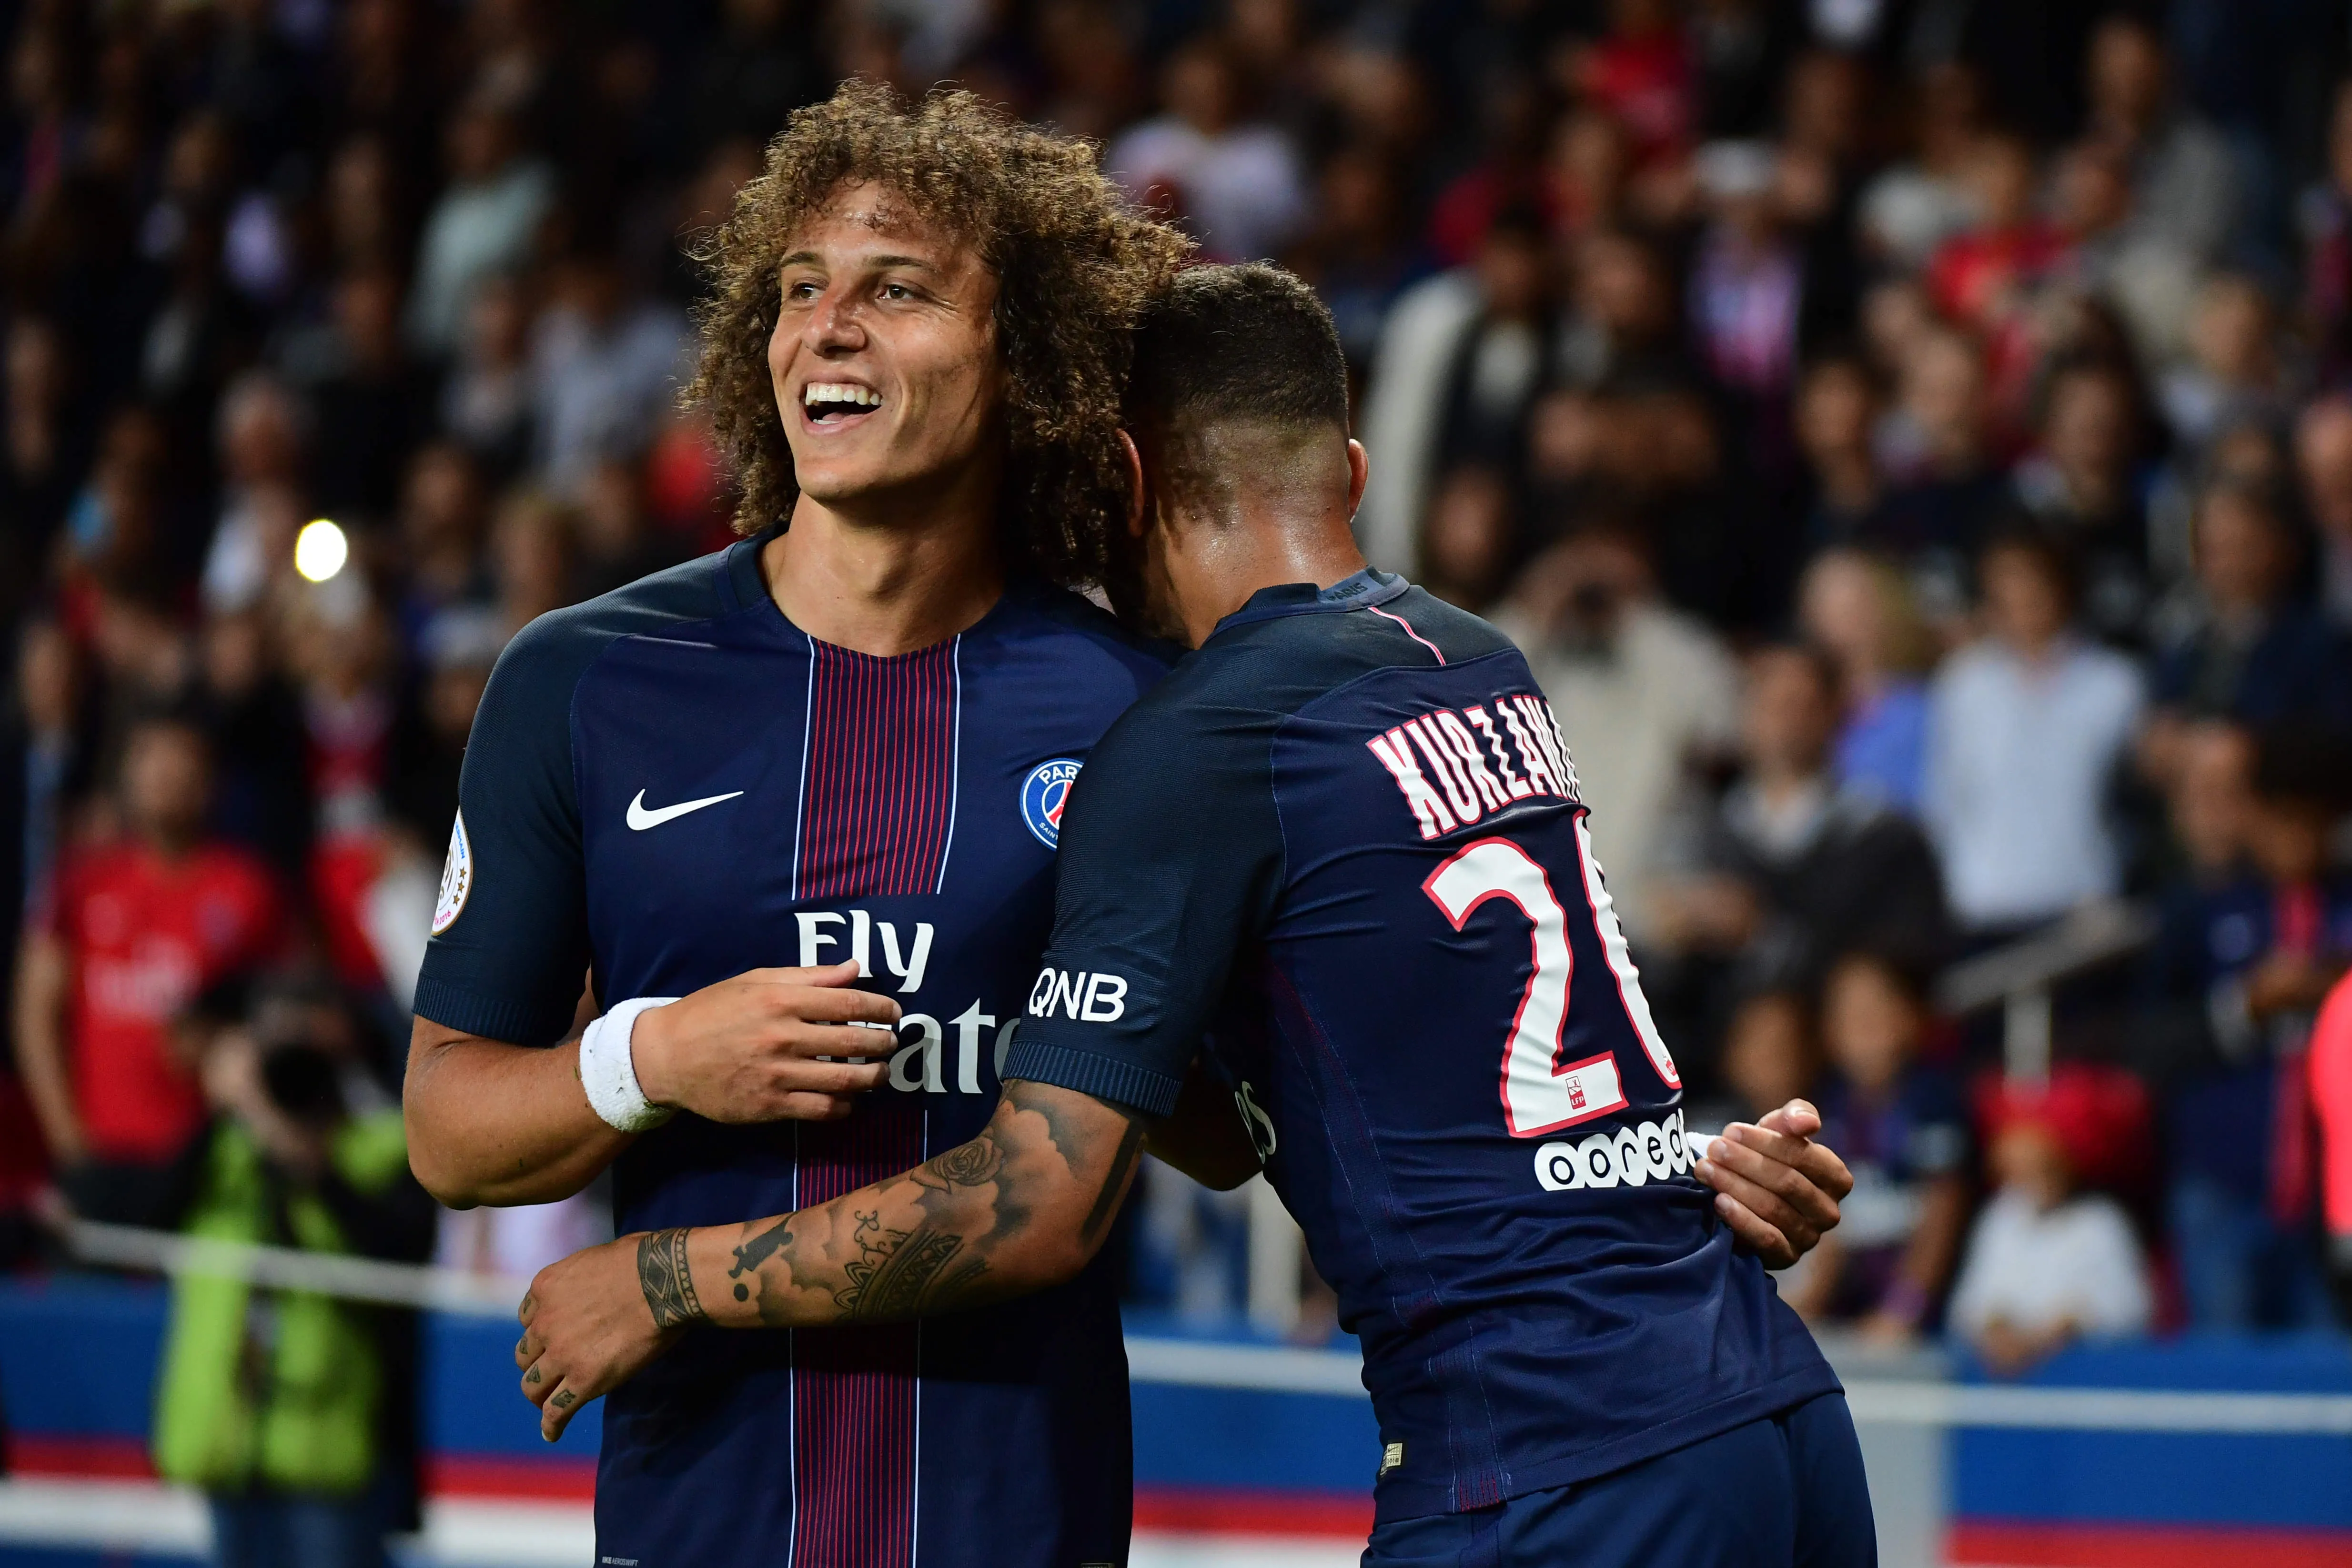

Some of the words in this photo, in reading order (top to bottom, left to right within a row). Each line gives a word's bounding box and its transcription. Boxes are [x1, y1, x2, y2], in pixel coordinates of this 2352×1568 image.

[1038, 765, 1078, 785] PAR
[794, 909, 934, 993] Fly
[1029, 967, 1128, 1022] QNB
[1571, 1096, 1585, 1106] LFP
[1548, 1114, 1691, 1185] oored
